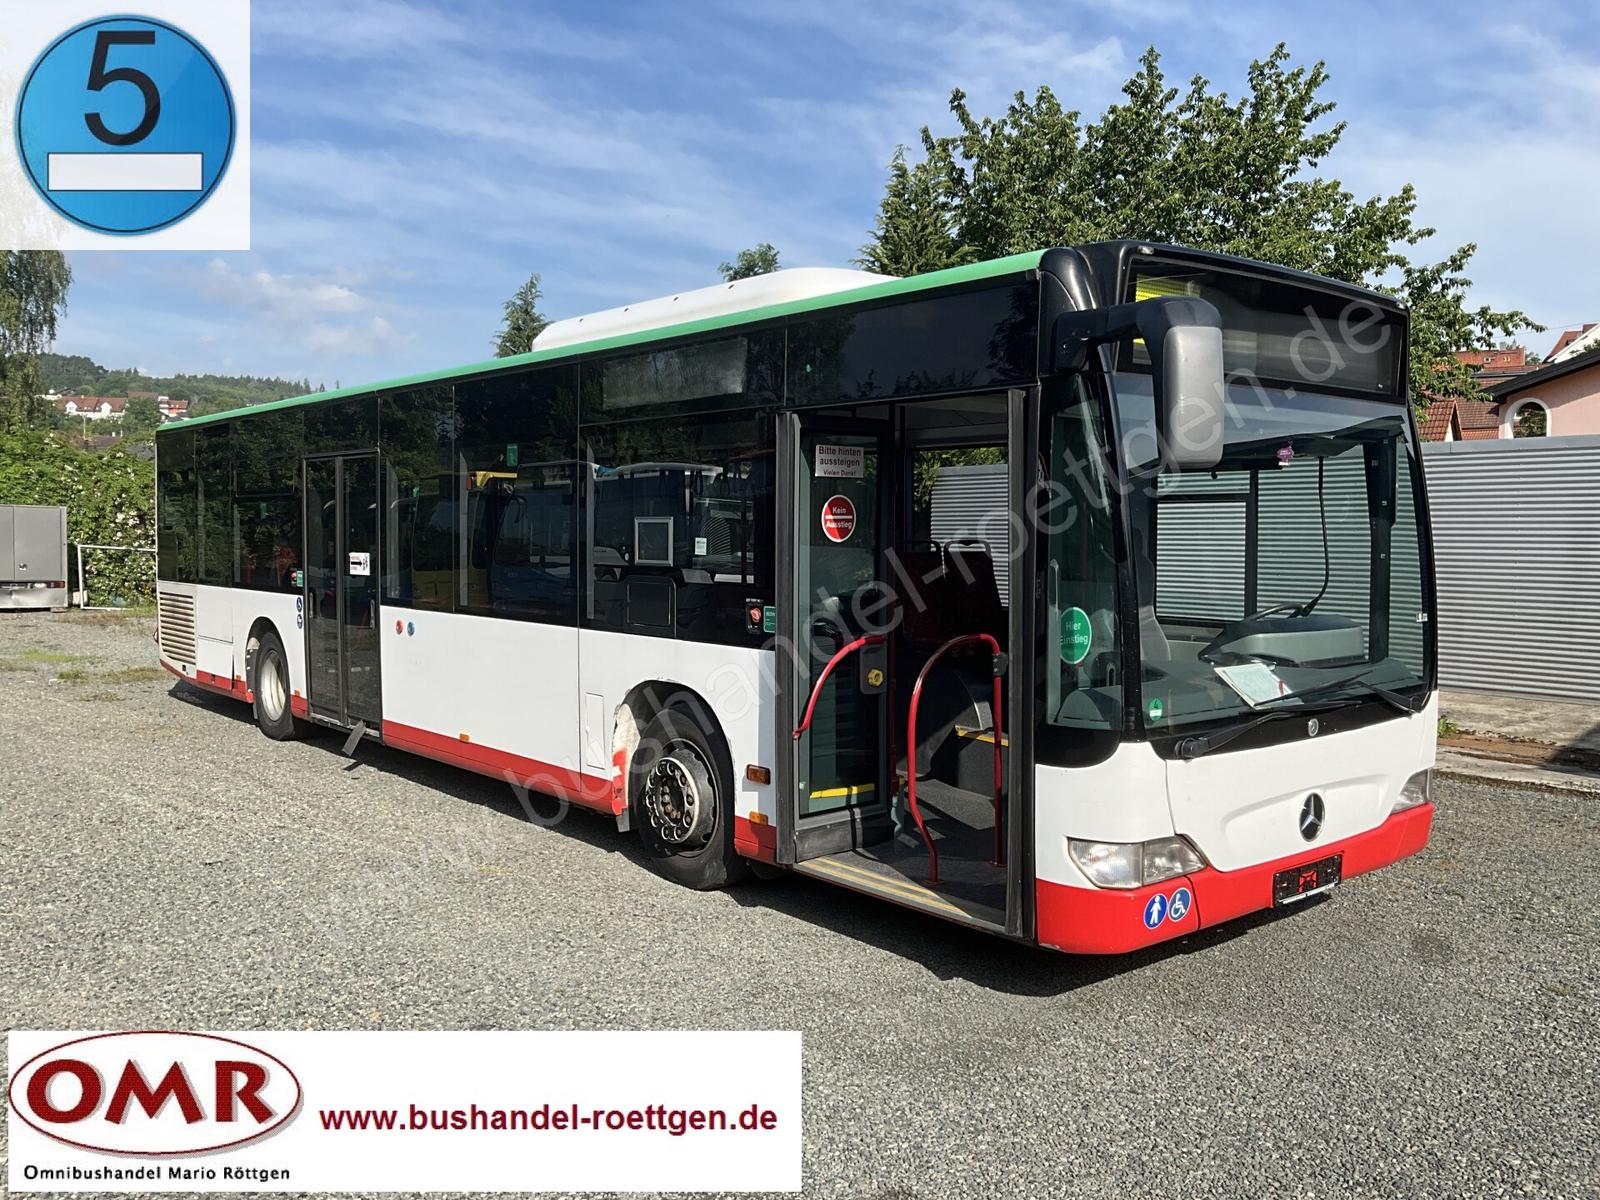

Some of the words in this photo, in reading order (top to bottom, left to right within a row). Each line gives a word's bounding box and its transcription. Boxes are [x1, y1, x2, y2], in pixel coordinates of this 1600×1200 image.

[818, 446, 837, 455] Bitte
[838, 447, 861, 457] hinten
[819, 457, 860, 468] aussteigen
[832, 506, 847, 514] Kein
[825, 520, 853, 530] Ausstieg
[1065, 621, 1082, 631] Hier
